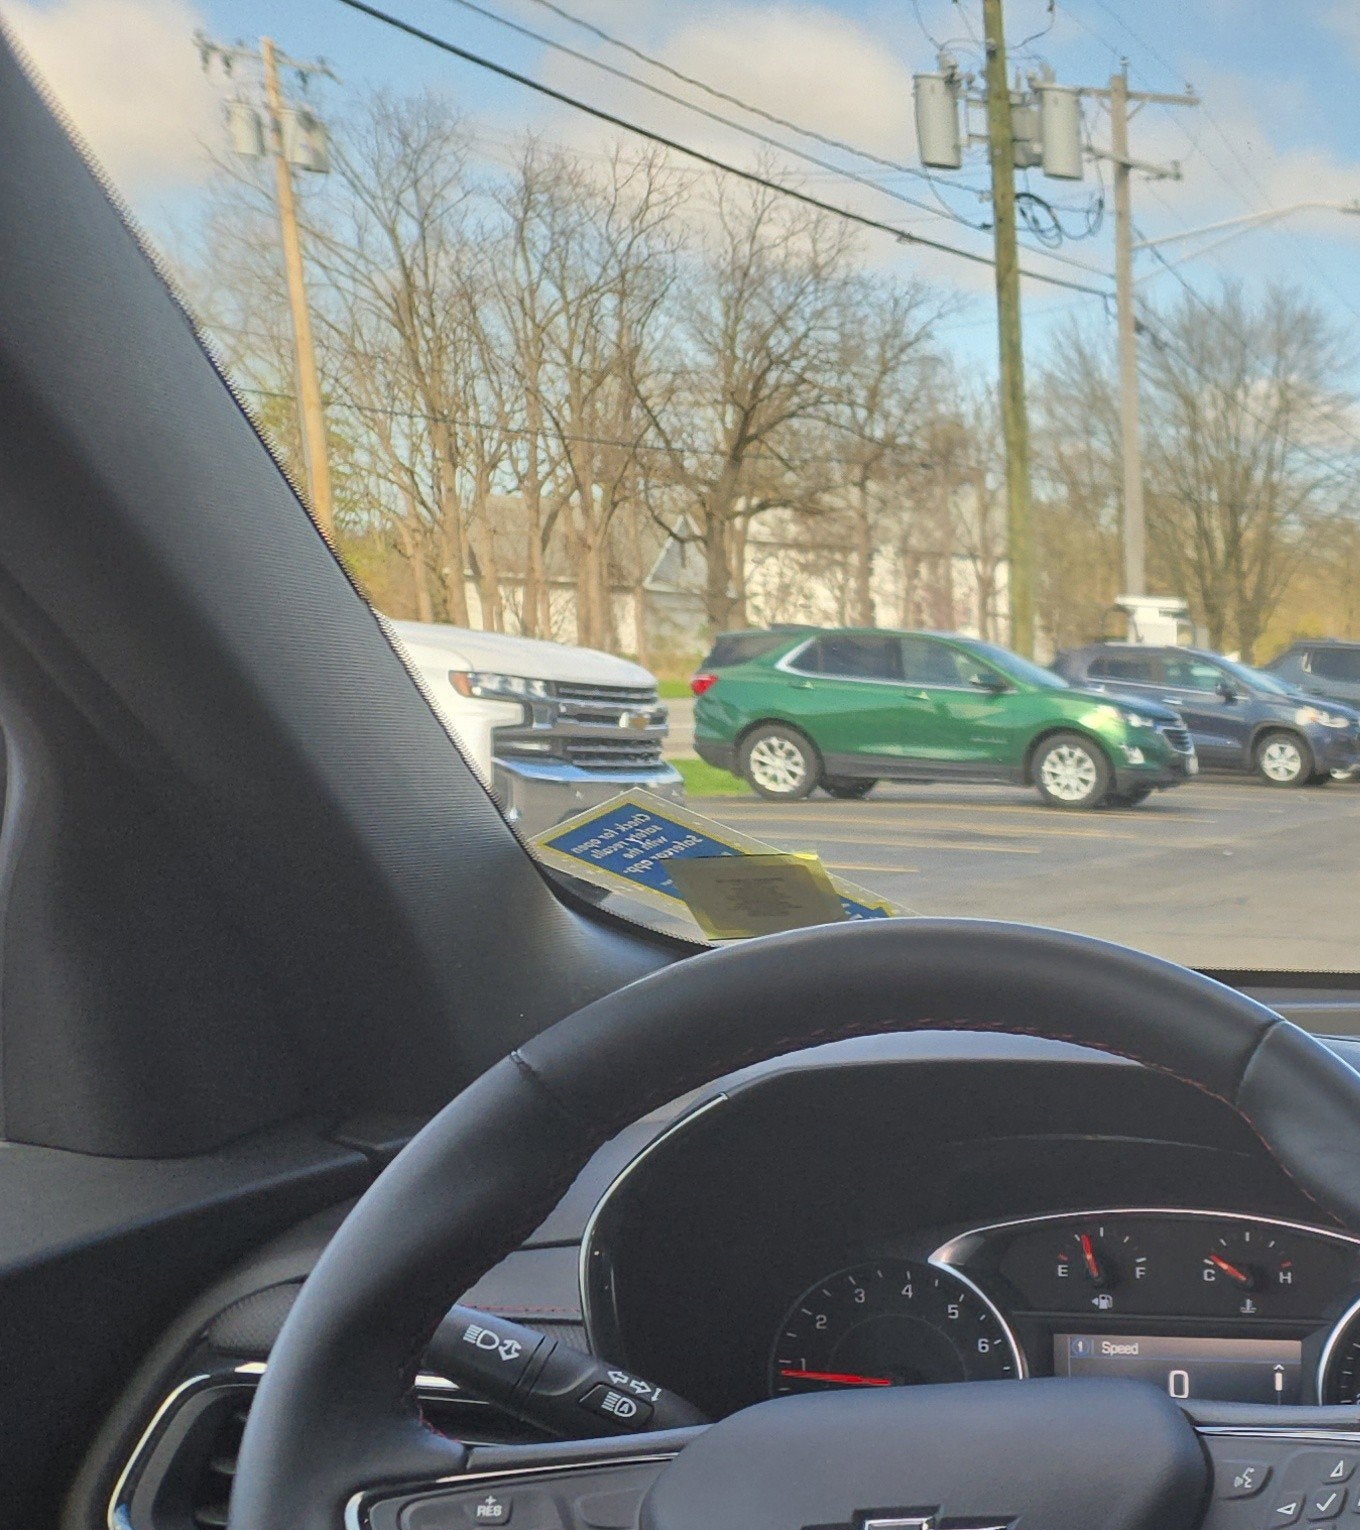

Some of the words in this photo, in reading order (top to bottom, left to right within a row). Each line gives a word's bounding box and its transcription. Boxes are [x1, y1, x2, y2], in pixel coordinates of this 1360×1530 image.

[854, 1288, 866, 1303] 3
[901, 1284, 914, 1298] 4
[947, 1304, 959, 1319] 5
[815, 1315, 827, 1330] 2
[977, 1338, 989, 1353] 6
[1101, 1341, 1140, 1356] Speed
[1168, 1370, 1190, 1399] 0
